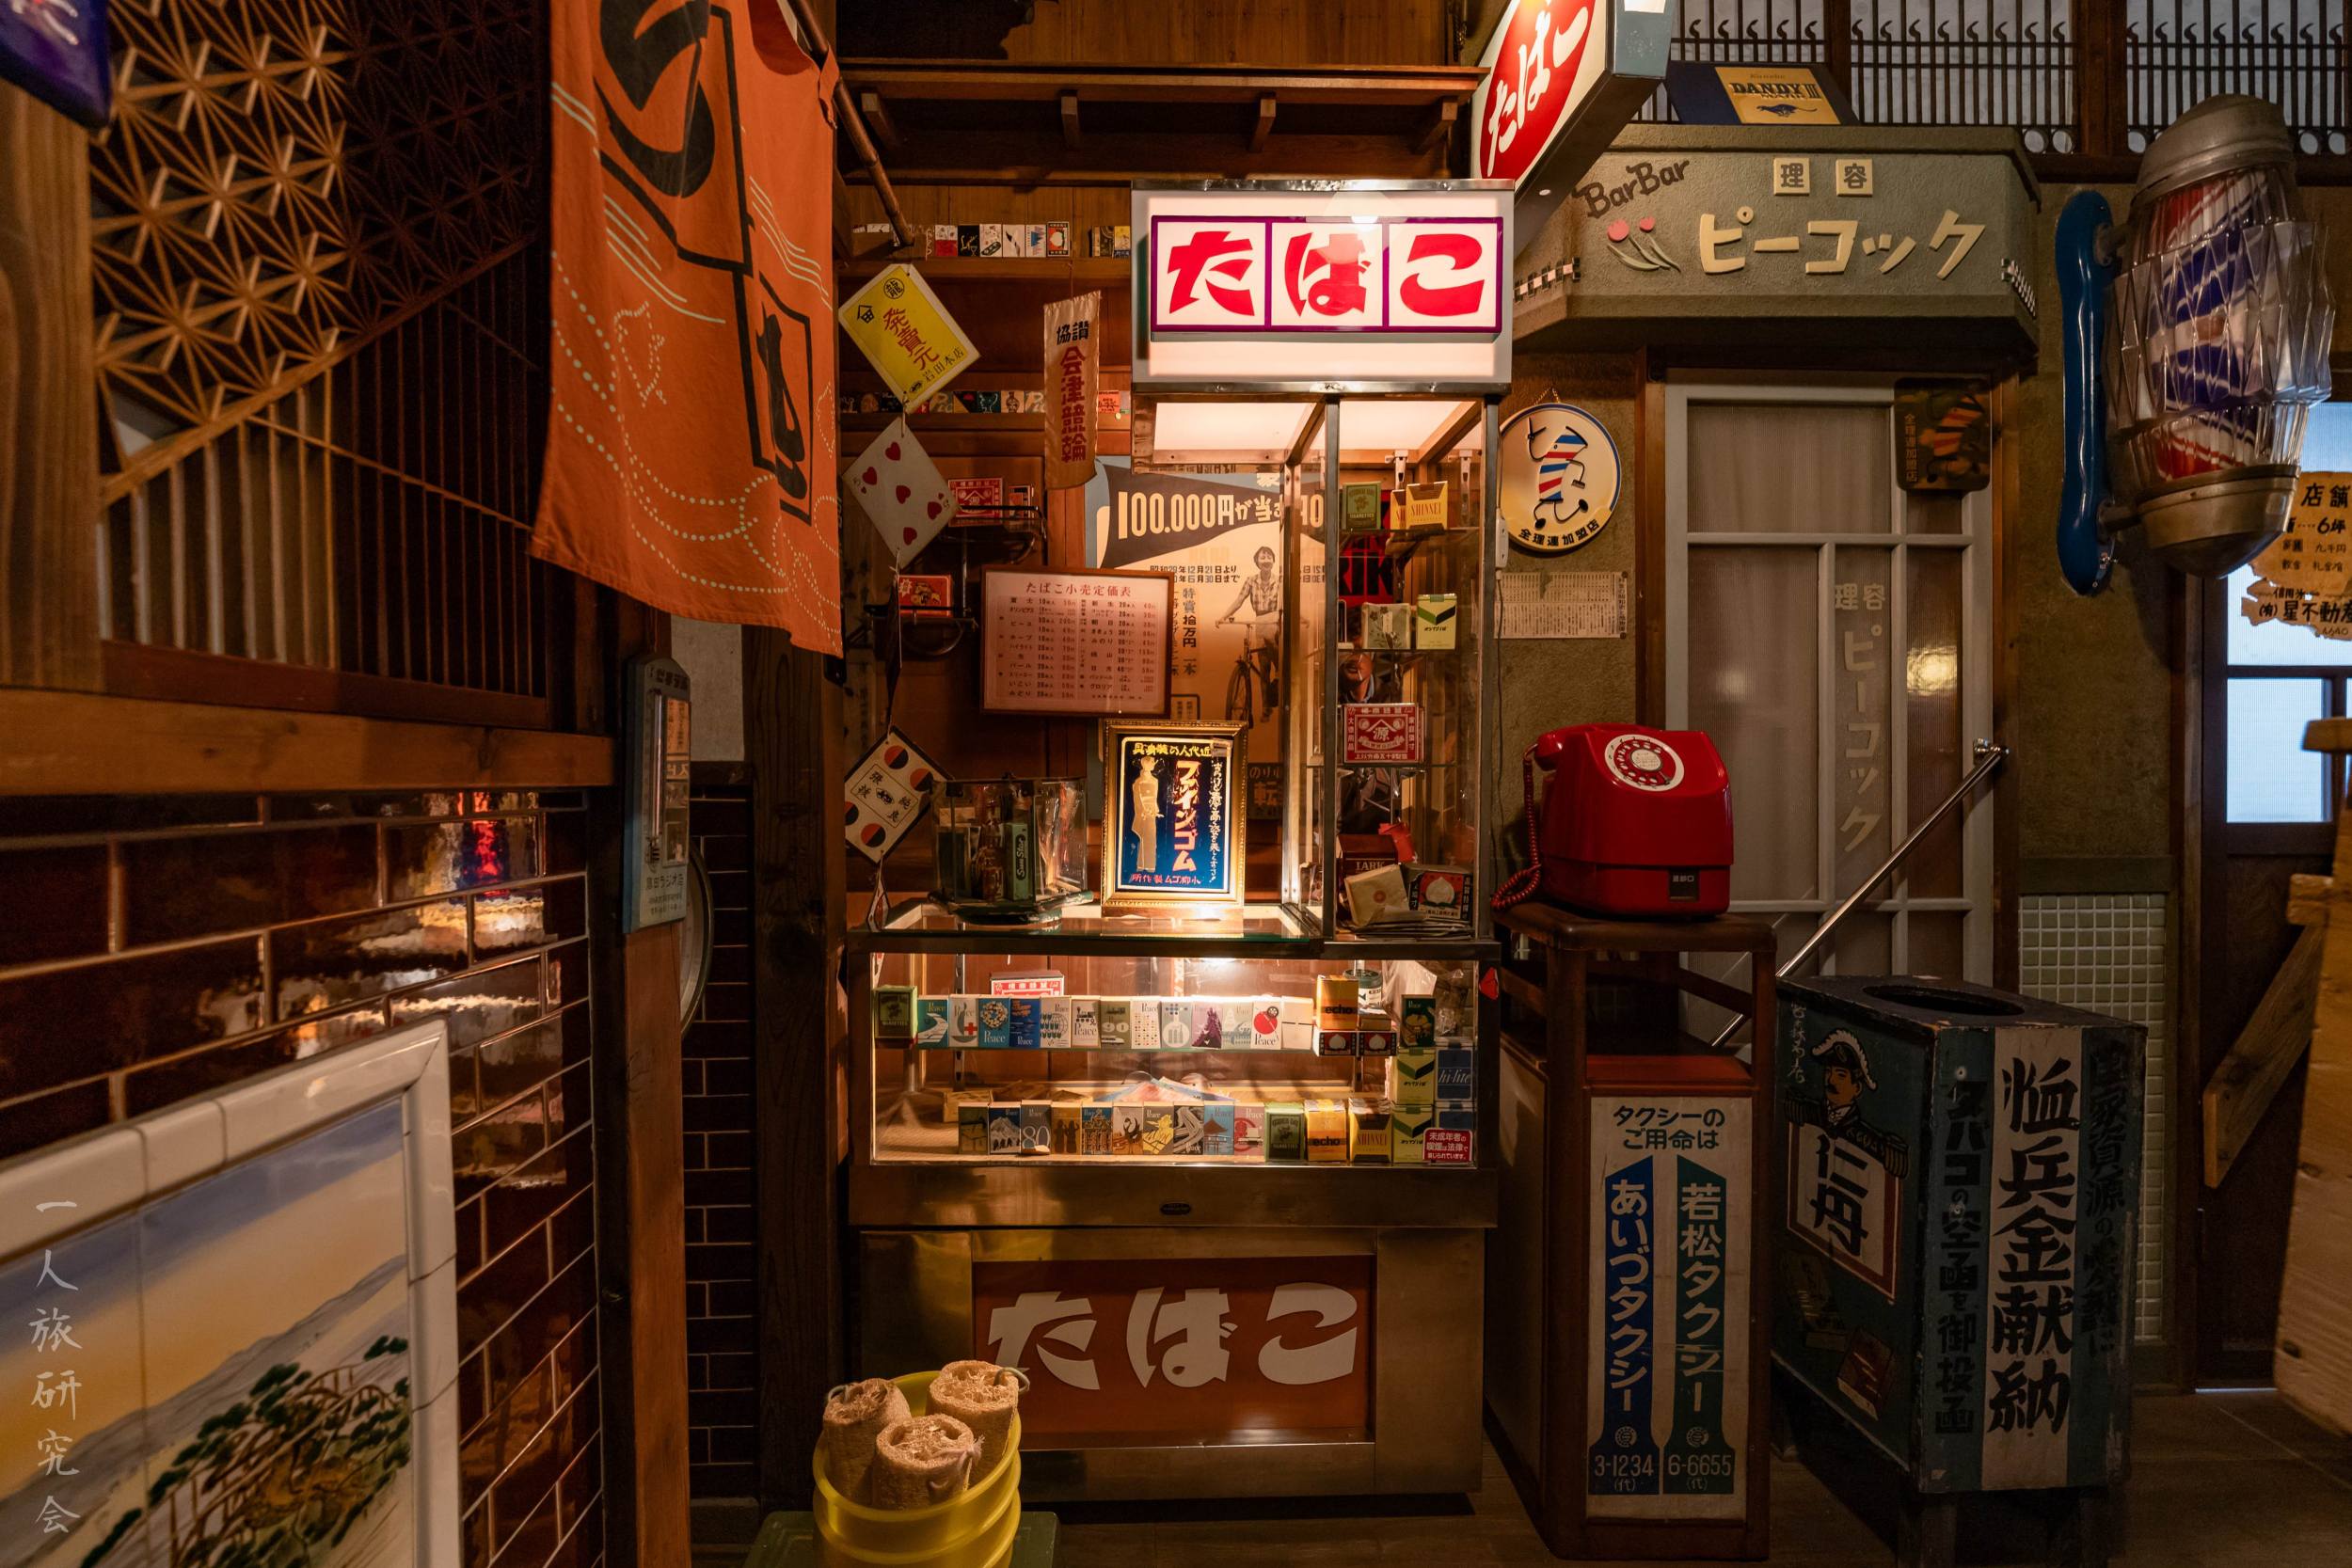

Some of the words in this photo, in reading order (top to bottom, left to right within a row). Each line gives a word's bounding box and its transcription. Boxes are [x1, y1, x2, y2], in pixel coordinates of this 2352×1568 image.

[1729, 83, 1801, 94] DANDY
[1779, 162, 1868, 189] 理容
[1573, 159, 1691, 218] BarBar
[1699, 205, 1986, 279] ピーコック
[1167, 230, 1486, 317] たばこ
[2301, 483, 2351, 509] 店舗
[1411, 502, 1442, 515] SHINSEI
[1518, 519, 1599, 546] 全理連加盟店
[1835, 583, 1885, 610] 理容
[1839, 625, 1883, 852] ピーコック
[1325, 1004, 1354, 1016] echo
[983, 1029, 1007, 1043] Peace
[1017, 1035, 1033, 1046] Peace
[1073, 1022, 1098, 1037] Peace
[1254, 1034, 1278, 1046] Peace
[1246, 1107, 1264, 1119] Peace
[1613, 1105, 1725, 1127] タクシーの
[1312, 1135, 1341, 1147] echo
[1358, 1133, 1388, 1147] SHINSEI
[1429, 1132, 1467, 1142] 未成年者の
[1623, 1128, 1720, 1150] ご用命は
[1987, 1057, 2080, 1434] 恤兵金献納
[1610, 1180, 1650, 1411] あいづタクシー
[1679, 1182, 1723, 1412] 若松タクシー
[988, 1282, 1358, 1390] たばこ
[1595, 1454, 1654, 1477] 3-1234
[1667, 1454, 1732, 1476] 6-6655
